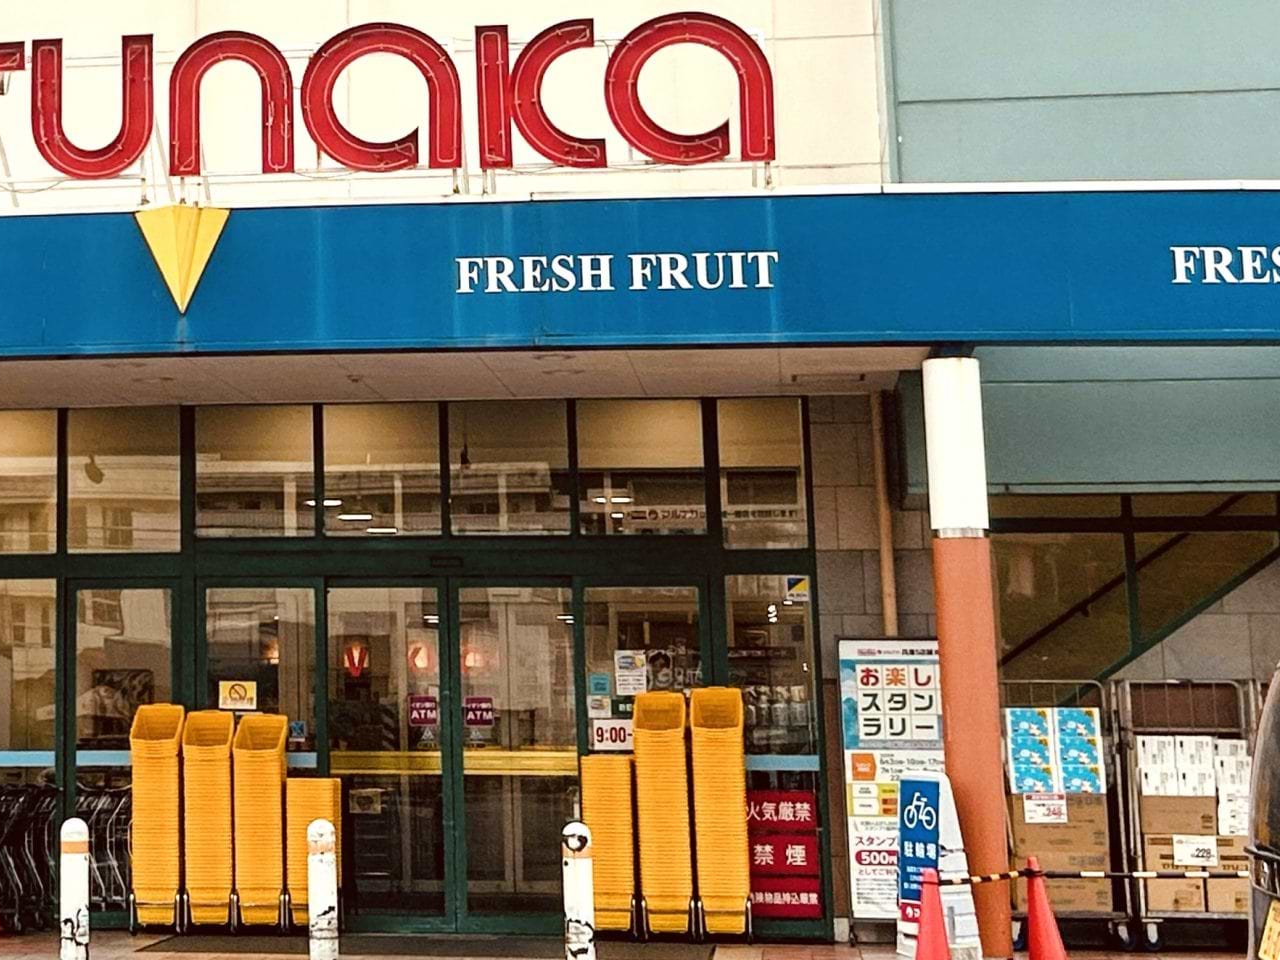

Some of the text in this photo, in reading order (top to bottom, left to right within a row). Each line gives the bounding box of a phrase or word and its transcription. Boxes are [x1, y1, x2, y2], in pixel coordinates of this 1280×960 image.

[455, 251, 779, 293] FRESH FRUIT
[860, 667, 932, 686] お楽し
[861, 693, 934, 712] スタン
[411, 711, 437, 720] ATM
[467, 711, 493, 720] ATM
[863, 717, 934, 737] ラリー
[746, 801, 812, 822] 火気厳禁
[753, 844, 807, 866] 禁煙
[904, 841, 937, 860] 駐輪場
